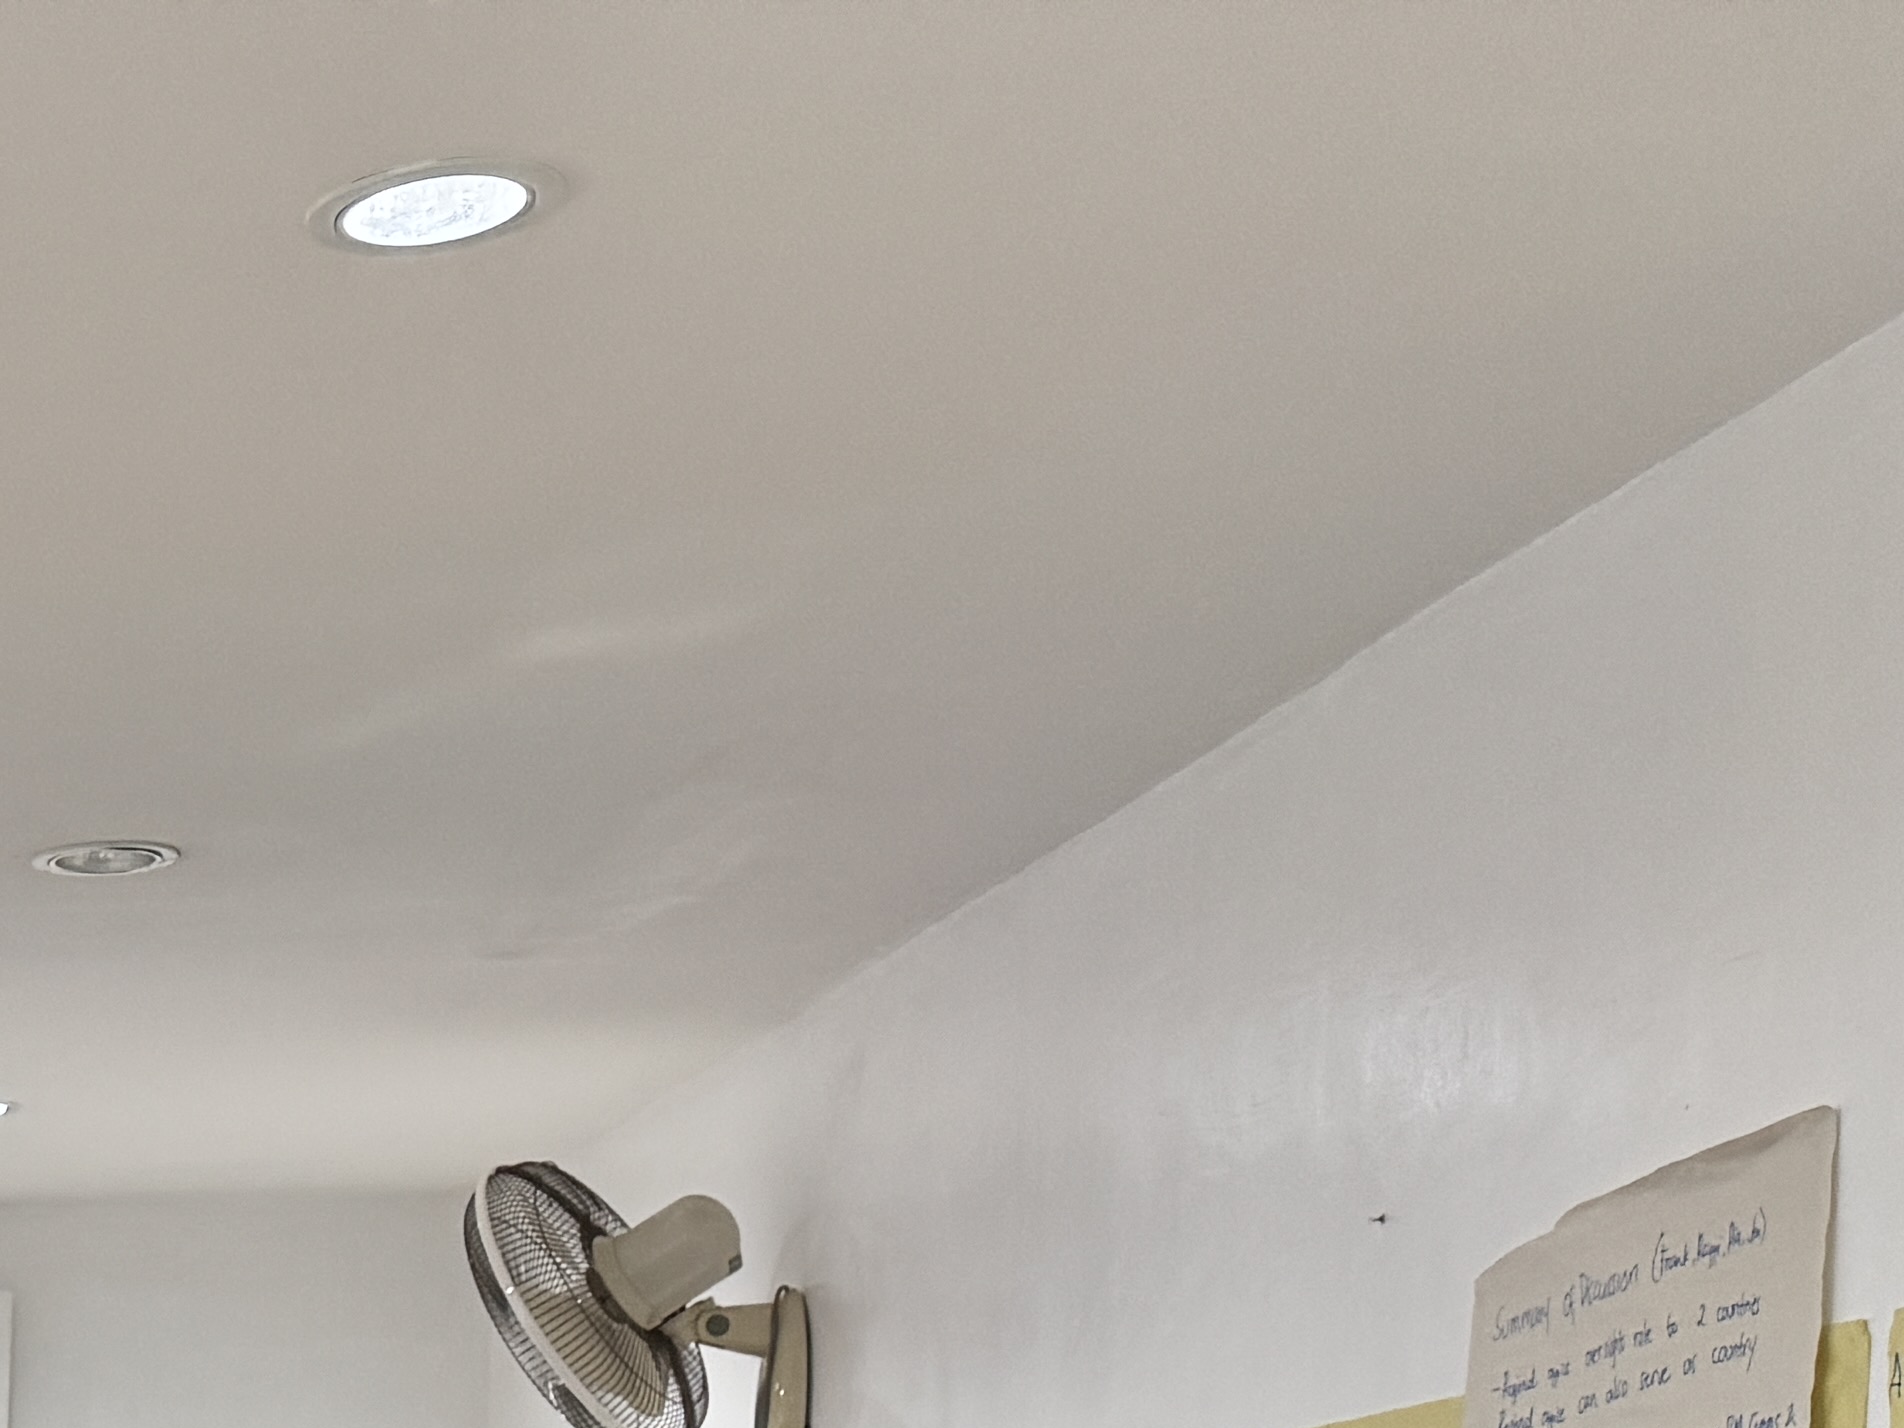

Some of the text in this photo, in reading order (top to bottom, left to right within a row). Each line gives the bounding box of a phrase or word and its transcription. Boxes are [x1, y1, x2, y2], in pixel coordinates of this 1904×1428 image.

[1493, 1297, 1551, 1341] Summary
[1667, 1313, 1678, 1337] to
[1697, 1304, 1705, 1326] 2
[1578, 1391, 1598, 1415] can
[1606, 1379, 1628, 1404] also
[1712, 1333, 1757, 1373] country
